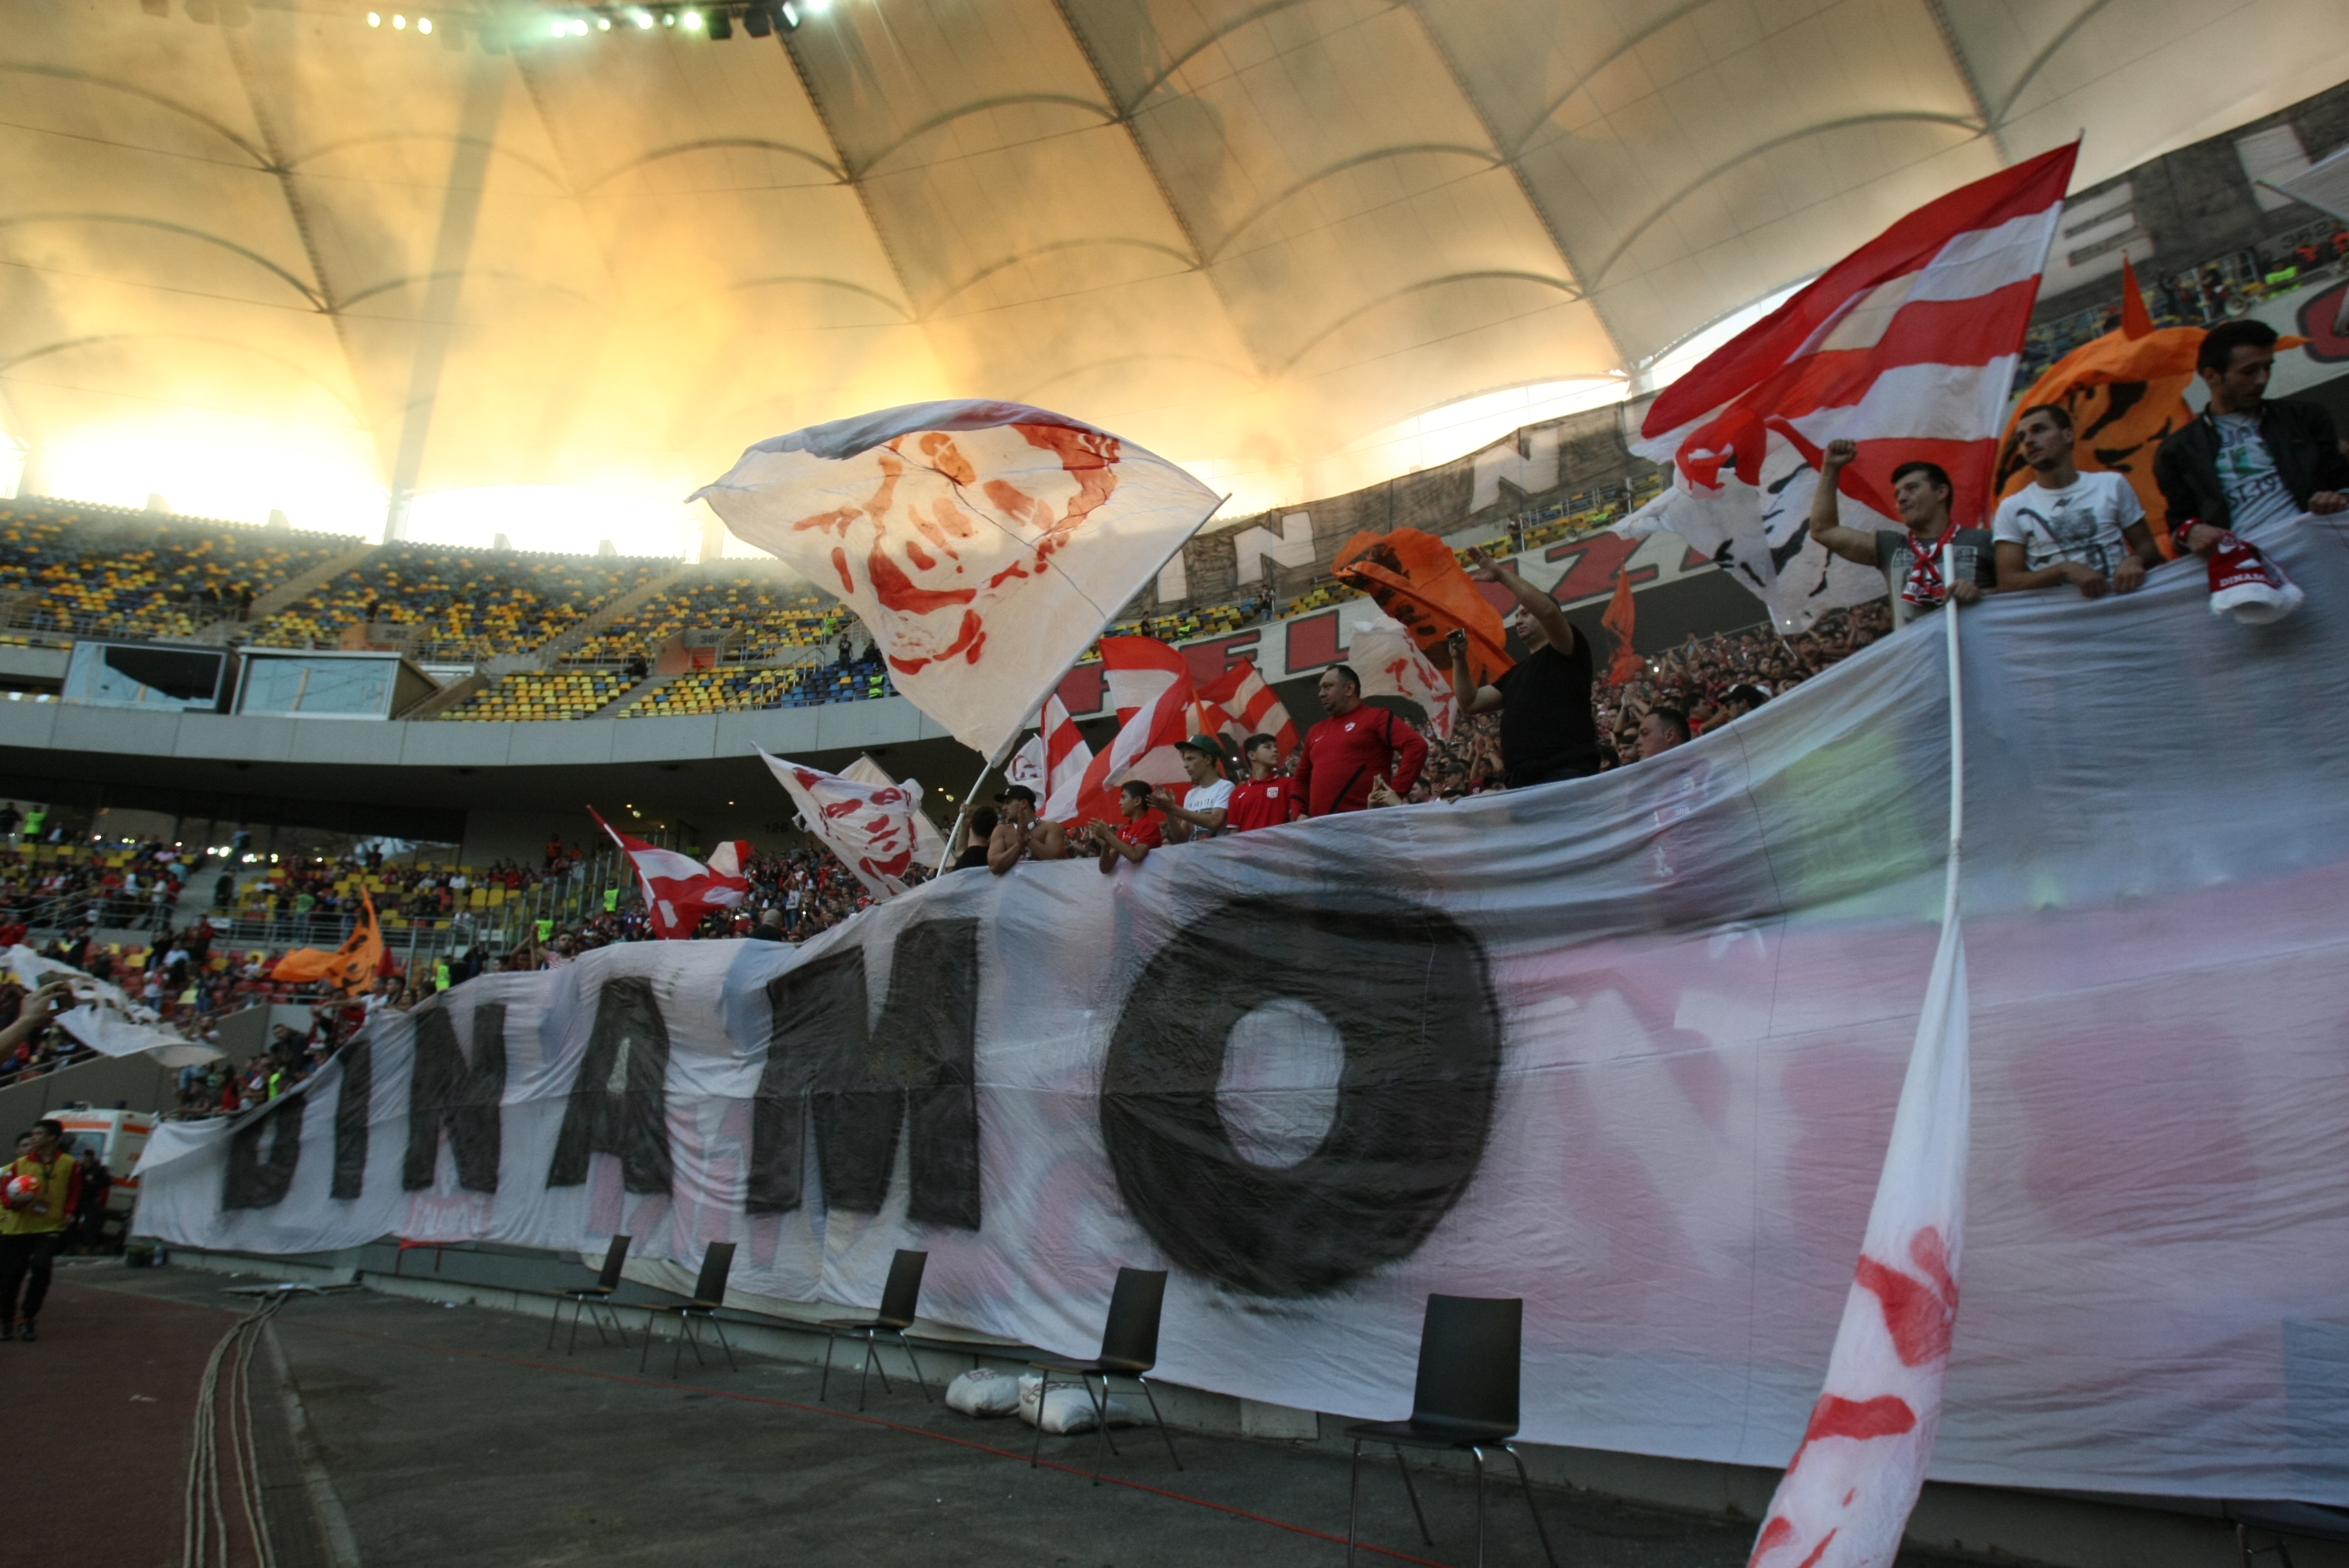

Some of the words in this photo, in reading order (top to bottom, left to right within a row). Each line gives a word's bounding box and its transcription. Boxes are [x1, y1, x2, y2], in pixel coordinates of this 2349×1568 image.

[2219, 572, 2267, 588] DINAM
[763, 822, 789, 834] 126
[220, 891, 1503, 1301] DINAMO
